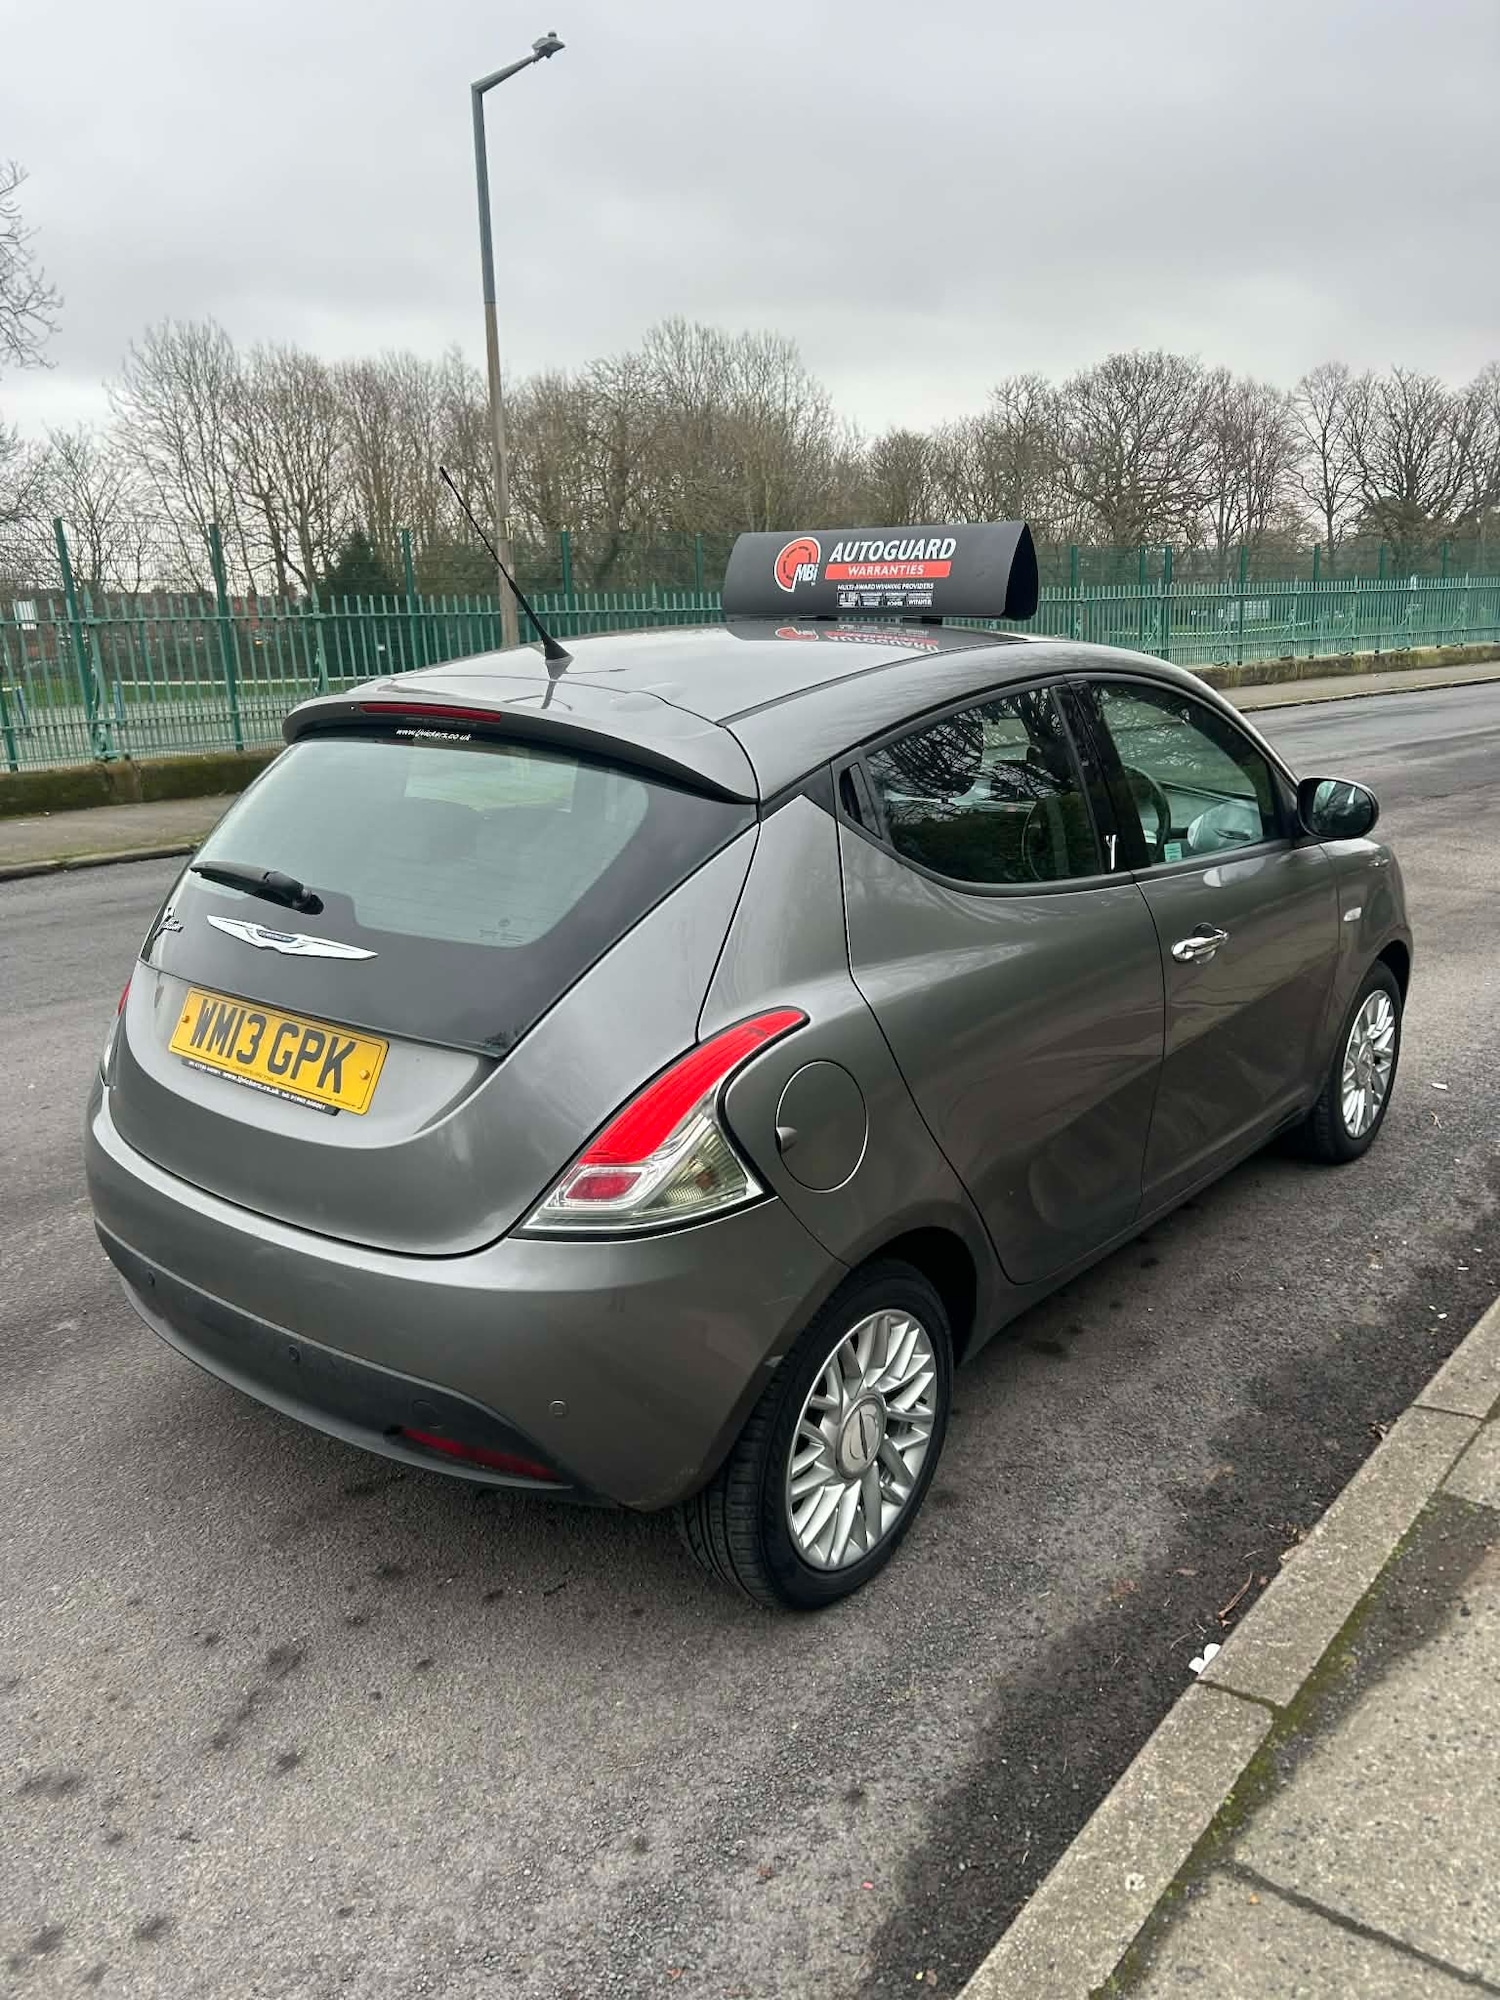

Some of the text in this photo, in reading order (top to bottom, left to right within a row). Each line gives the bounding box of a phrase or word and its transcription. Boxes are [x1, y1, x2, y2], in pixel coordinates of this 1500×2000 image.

[828, 537, 957, 563] AUTOGUARD
[796, 563, 819, 582] MBi
[848, 564, 925, 576] WARRANTIES
[902, 582, 934, 590] PROVIDERS
[189, 998, 357, 1094] WM13 GPK
